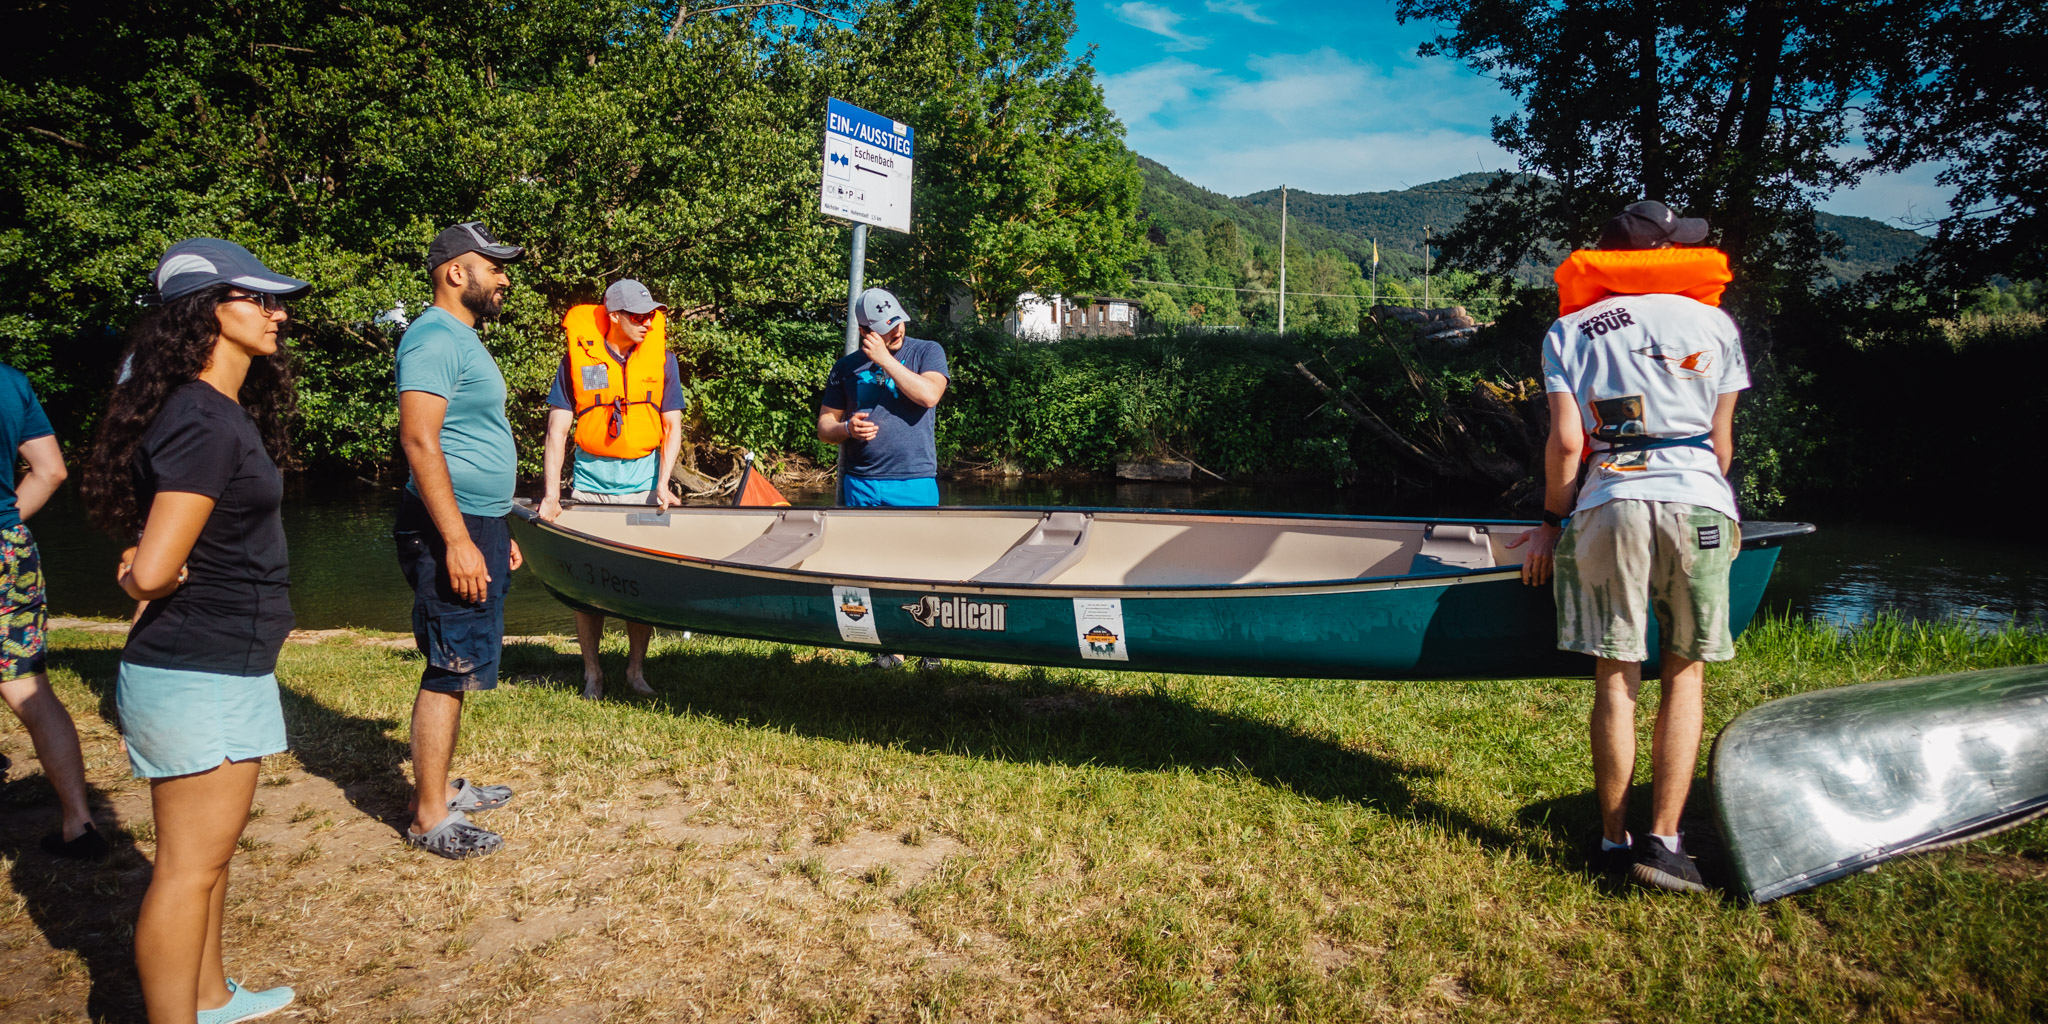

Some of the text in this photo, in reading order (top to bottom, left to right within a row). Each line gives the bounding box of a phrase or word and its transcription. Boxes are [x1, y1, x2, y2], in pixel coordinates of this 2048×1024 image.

[829, 112, 911, 156] EIN-/AUSSTIEG
[854, 146, 894, 169] Eschenbach
[1578, 307, 1626, 330] WORLD
[1582, 312, 1636, 341] TOUR
[584, 563, 595, 585] 3
[601, 568, 640, 597] Pers
[923, 595, 1006, 631] Pelican
